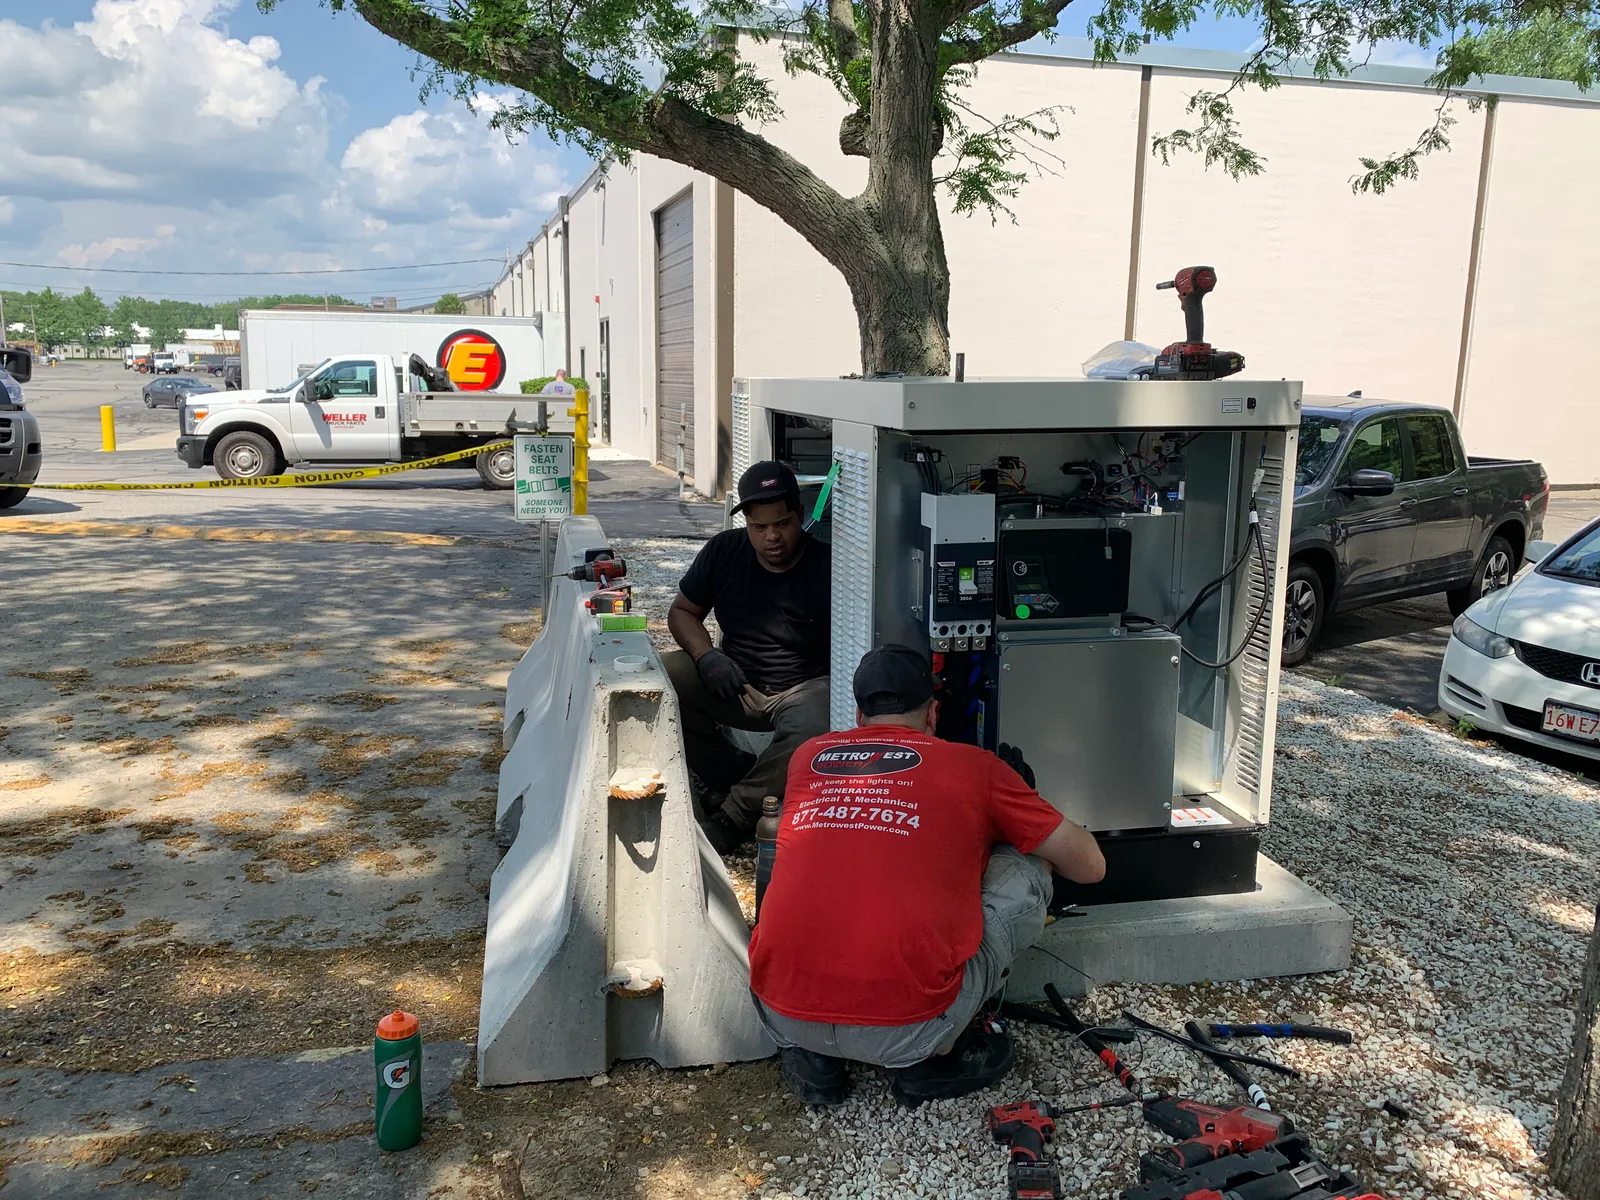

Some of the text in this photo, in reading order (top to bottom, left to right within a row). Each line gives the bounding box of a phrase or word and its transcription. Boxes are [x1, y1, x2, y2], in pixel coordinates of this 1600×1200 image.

[445, 343, 496, 384] E
[322, 413, 367, 421] WELLER
[524, 444, 563, 453] FASTEN
[531, 455, 556, 463] SEAT
[378, 457, 446, 474] CAUTION
[529, 466, 559, 474] BELTS
[294, 470, 365, 483] CAUTION
[209, 477, 280, 487] CAUTION
[525, 499, 564, 507] SOMEONE
[809, 781, 823, 790] We
[799, 796, 840, 809] Electrical
[855, 796, 918, 810] Mechanical
[791, 806, 920, 829] 877-487-7674
[793, 822, 910, 837] www.MetrowestPower.com
